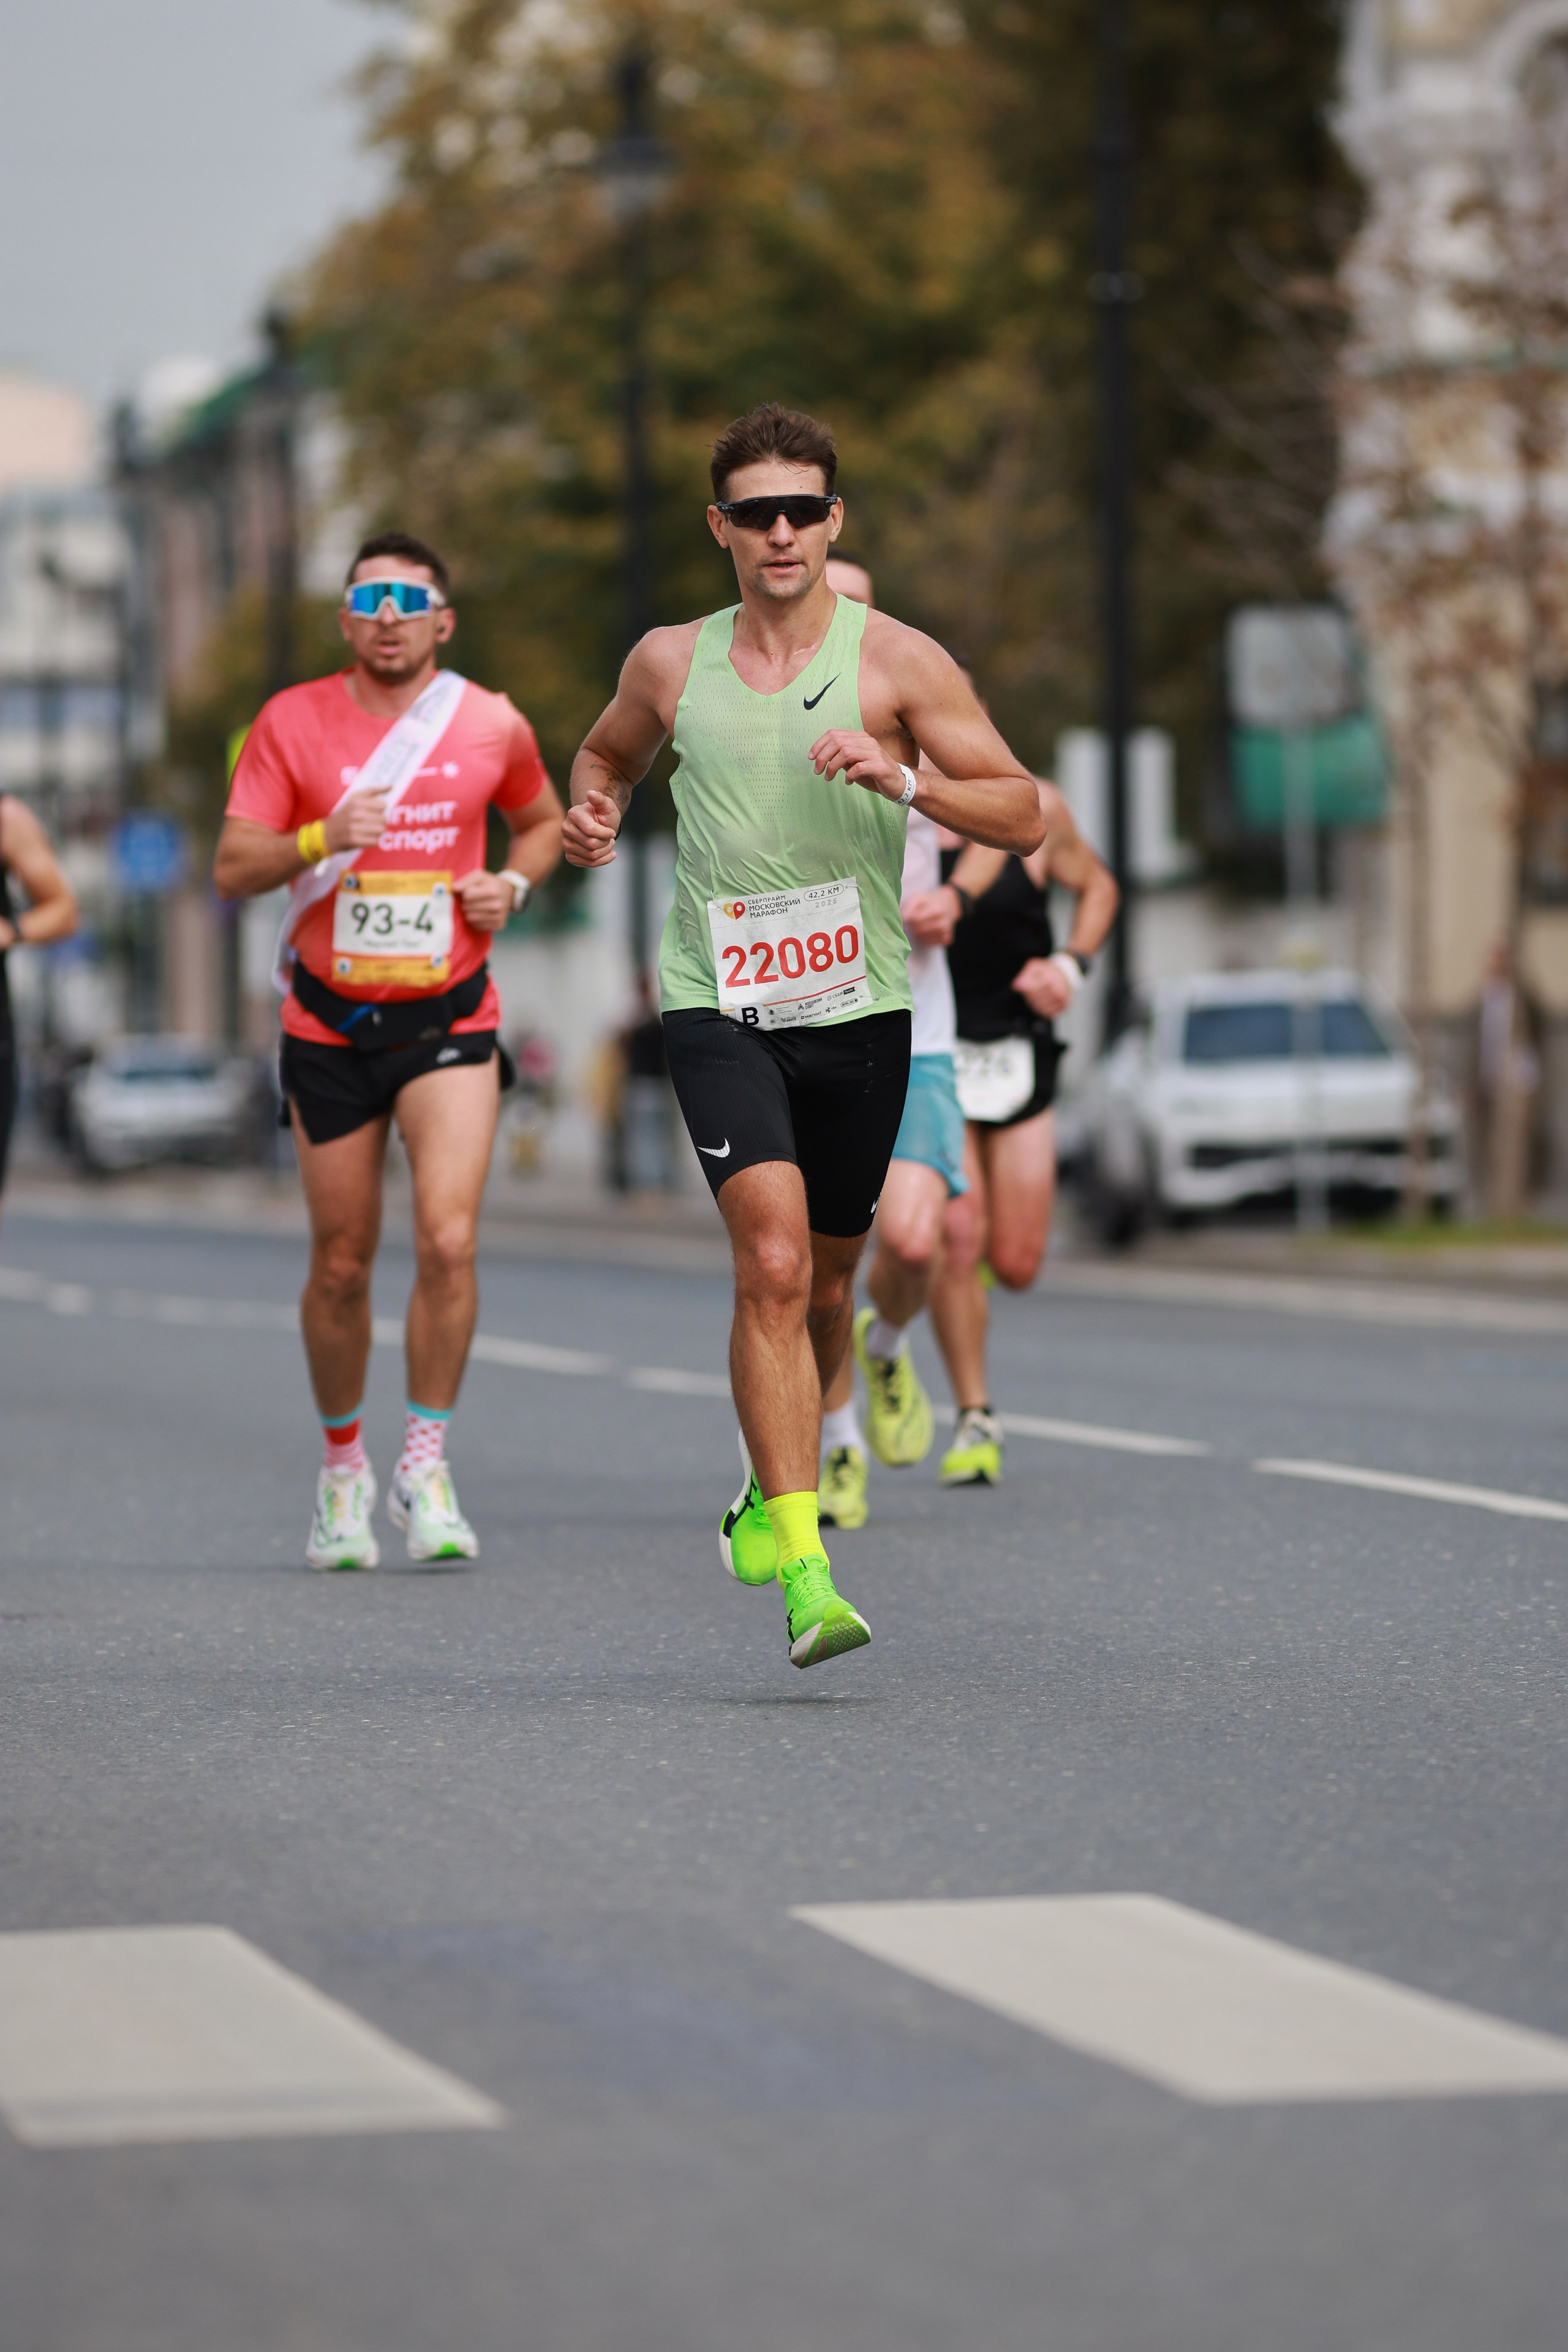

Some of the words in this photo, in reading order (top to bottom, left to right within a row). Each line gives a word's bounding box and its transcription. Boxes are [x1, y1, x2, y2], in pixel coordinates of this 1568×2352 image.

[377, 826, 460, 854] спорт
[748, 895, 786, 905] СБЕРПРАЙМ
[809, 889, 825, 899] 42,2
[827, 886, 840, 895] КМ
[748, 898, 801, 911] МОСКОВСКИЙ
[350, 902, 434, 937] 93-4
[750, 907, 789, 919] МАРАФОН
[722, 925, 859, 989] 22080
[741, 1006, 760, 1026] B
